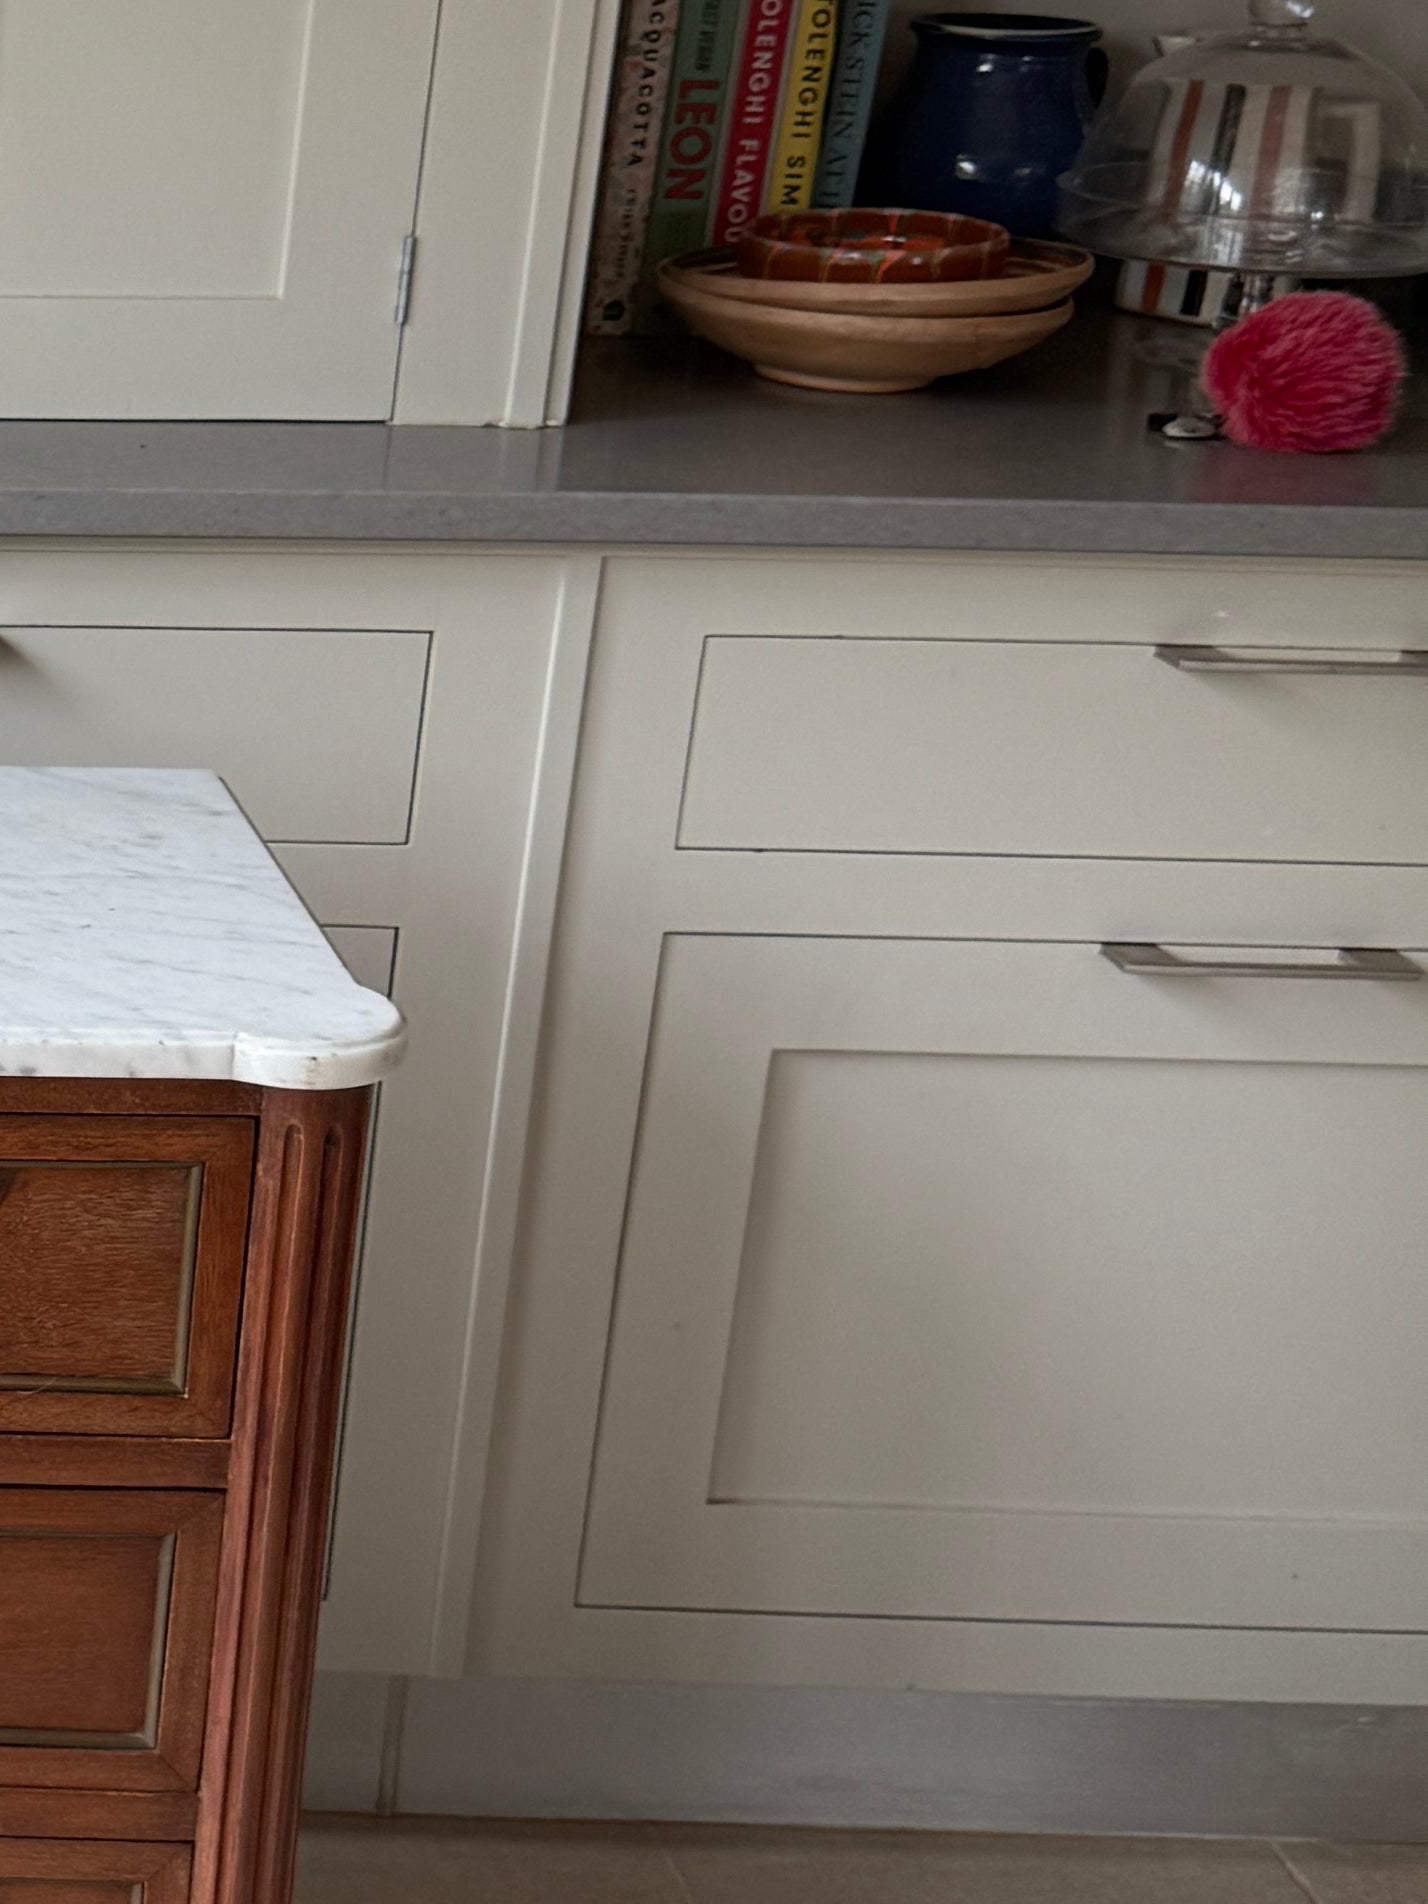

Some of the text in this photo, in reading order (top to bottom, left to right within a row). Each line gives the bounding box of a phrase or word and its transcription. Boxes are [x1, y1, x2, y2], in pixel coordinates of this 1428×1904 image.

[834, 57, 863, 137] STEIN
[663, 80, 721, 201] LEON
[780, 155, 806, 204] SIM
